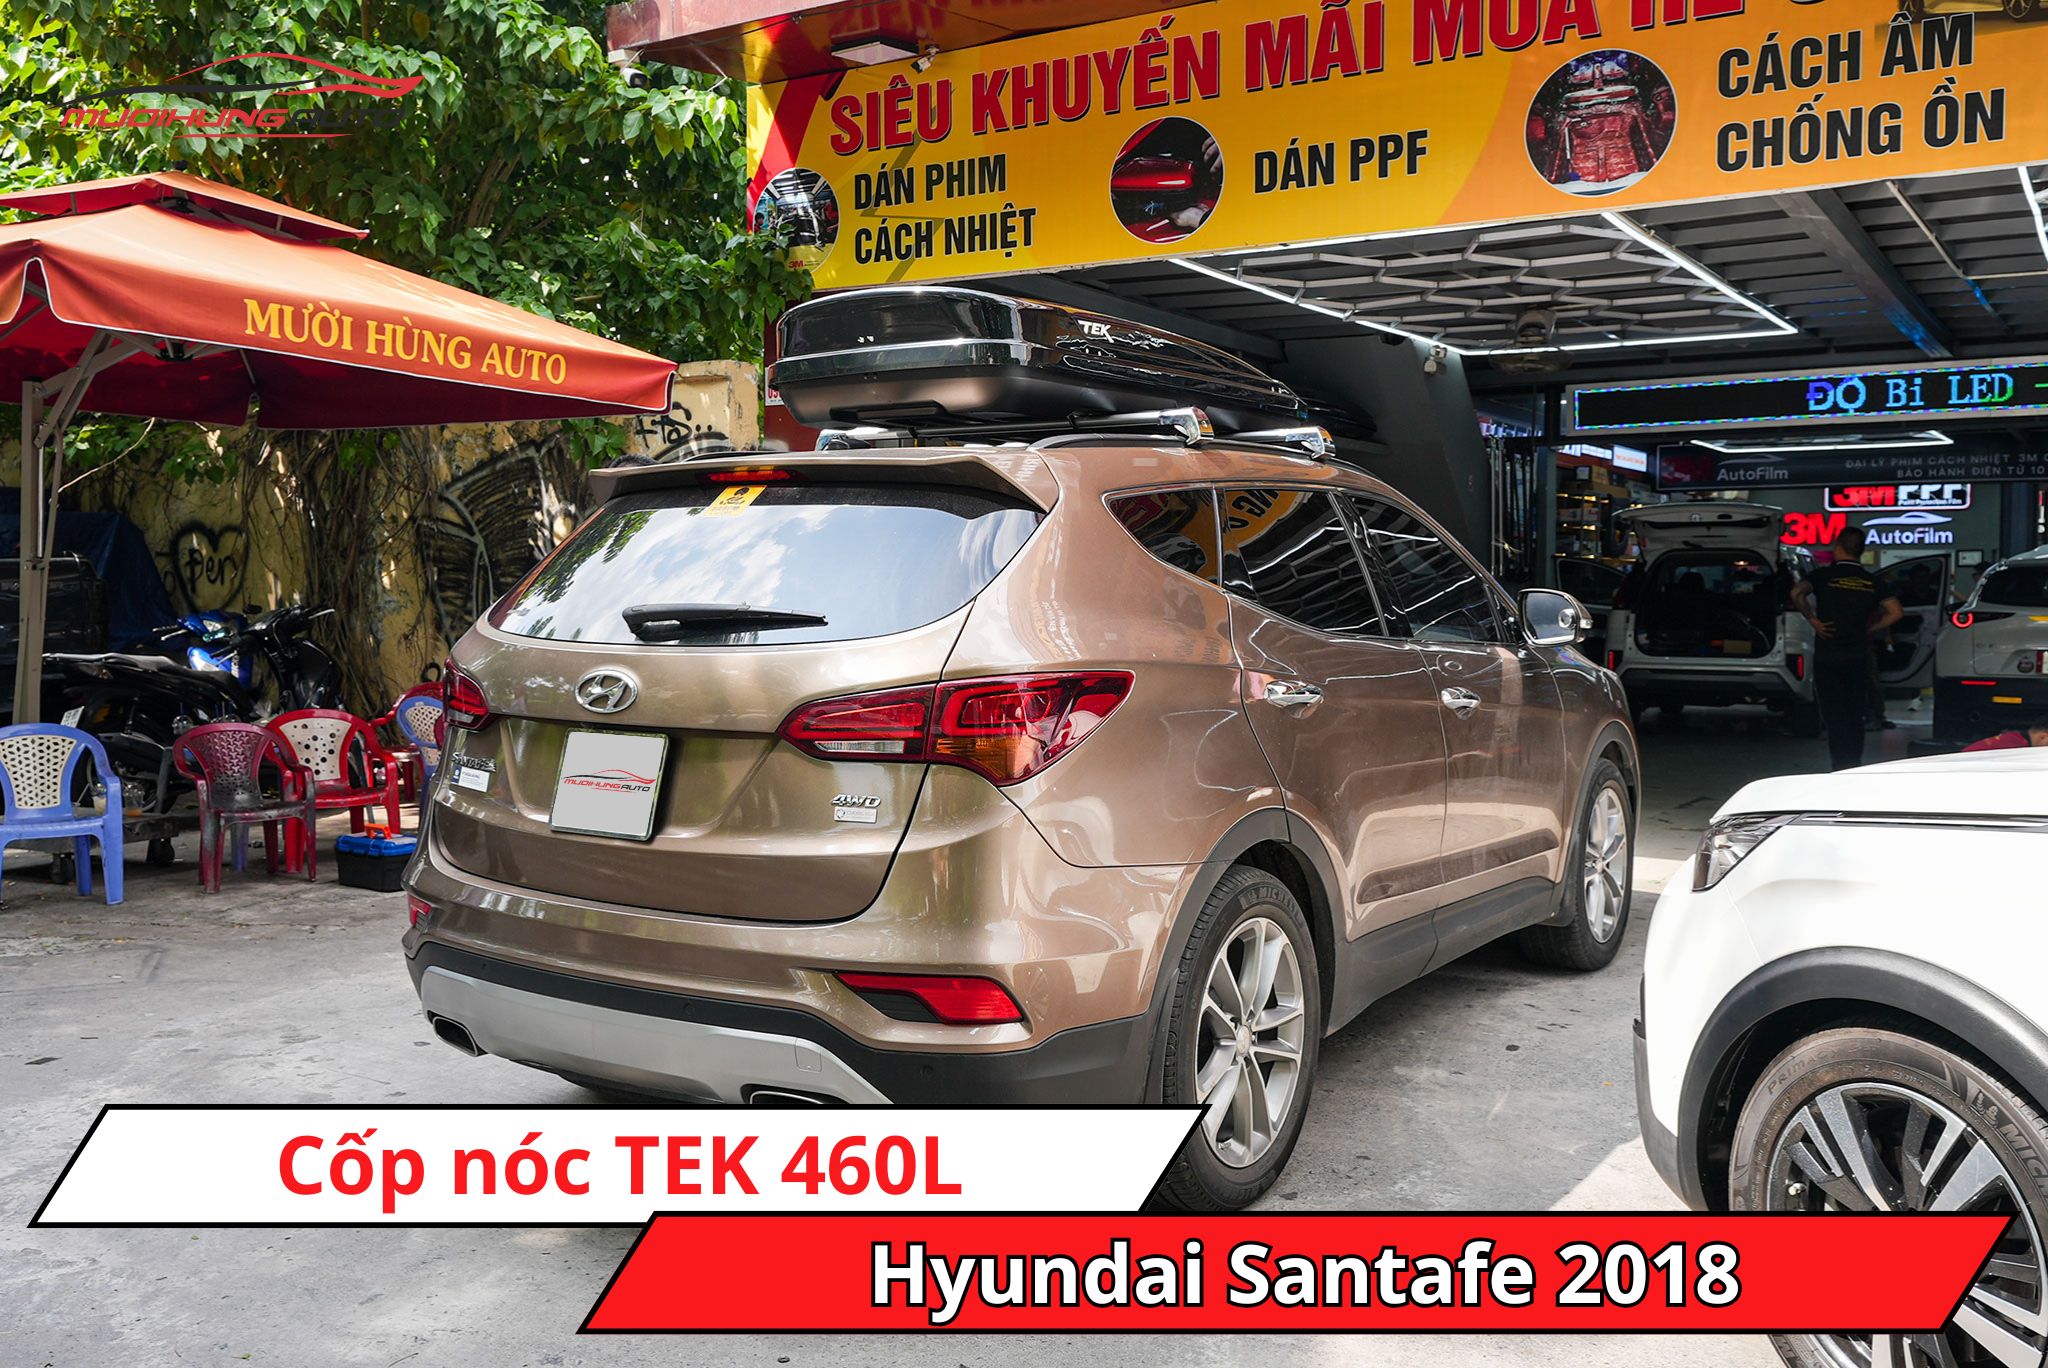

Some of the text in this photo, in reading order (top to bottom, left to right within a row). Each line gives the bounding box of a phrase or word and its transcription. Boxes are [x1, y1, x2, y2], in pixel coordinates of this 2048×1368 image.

[830, 74, 952, 156] SIÊU
[972, 15, 1220, 136] KHUYẾN
[1244, 0, 1384, 93] MÃI
[1717, 12, 1974, 99] CÁCH ÂM
[1716, 76, 2005, 172] CHỐNG ỒN
[853, 153, 1006, 210] DÁN PHIM
[1254, 129, 1428, 194] DÁN PPF
[854, 202, 1036, 264] CÁCH NHIỆT
[244, 298, 568, 385] MƯỜI HÙNG AUTO
[1077, 319, 1114, 343] TEK
[1886, 377, 1925, 408] Bi
[1948, 373, 2014, 405] LED
[1717, 467, 1789, 482] AutoFilm
[1891, 457, 1923, 467] PHIM
[1779, 512, 1847, 545] 3M
[1865, 528, 1953, 545] AutoFilm
[831, 794, 881, 808] 4WD
